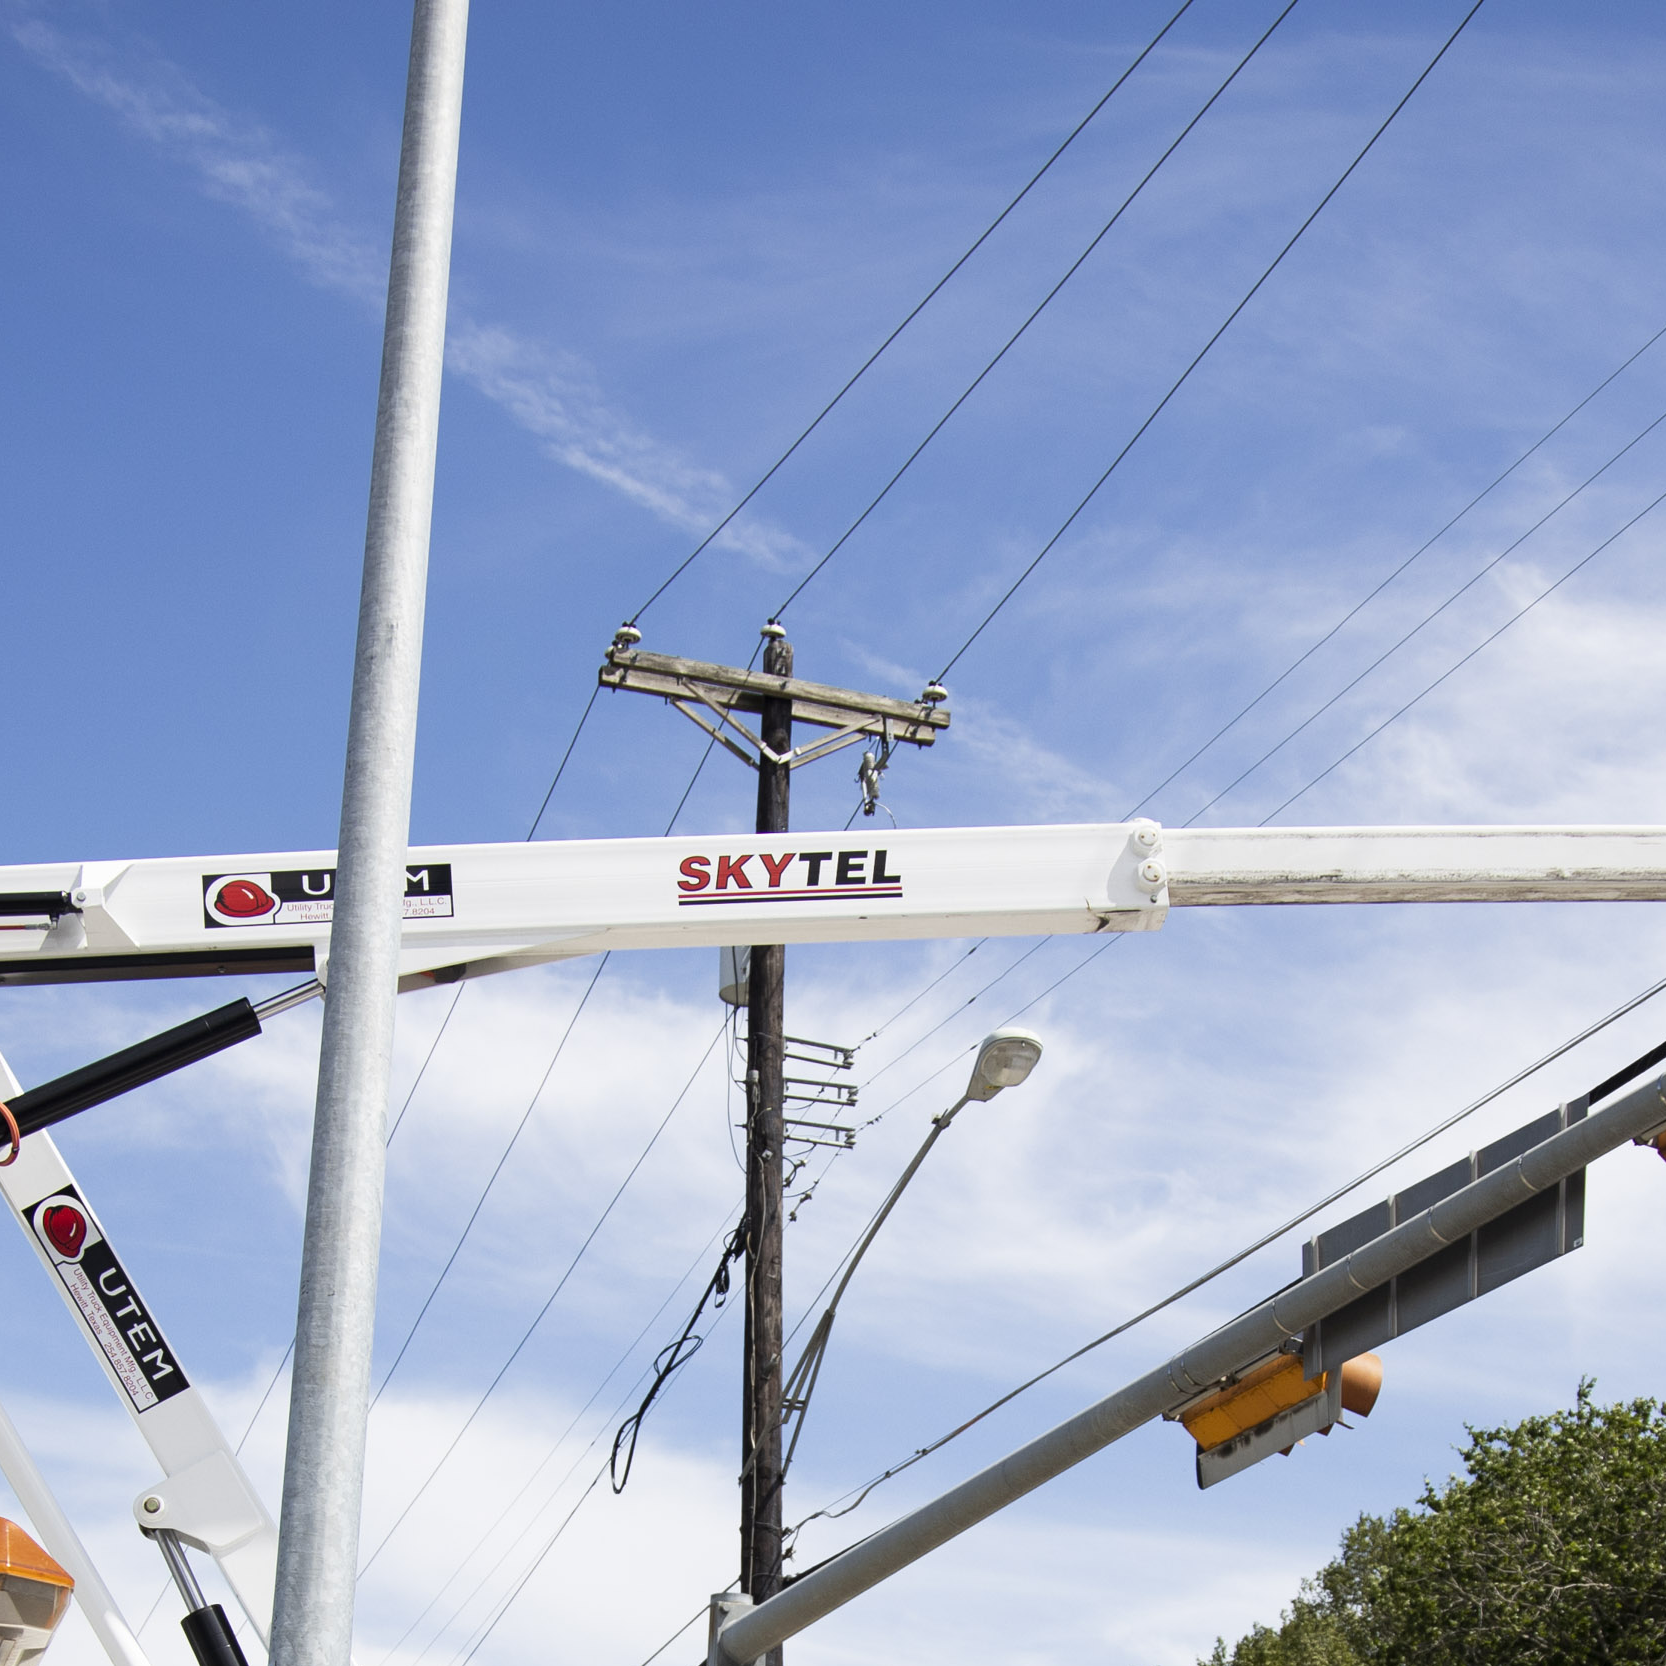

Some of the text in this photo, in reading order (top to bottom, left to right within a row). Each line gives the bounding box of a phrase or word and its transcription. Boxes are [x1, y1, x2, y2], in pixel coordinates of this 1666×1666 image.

[302, 869, 429, 896] UM
[677, 850, 901, 892] SKYTEL
[287, 904, 312, 912] Utility
[73, 1267, 90, 1291] Utility
[87, 1289, 103, 1314] Truck
[99, 1312, 128, 1358] Equipment
[99, 1267, 174, 1381] UTEM
[86, 1310, 103, 1336] Texas
[103, 1342, 139, 1397] 254.857.8204
